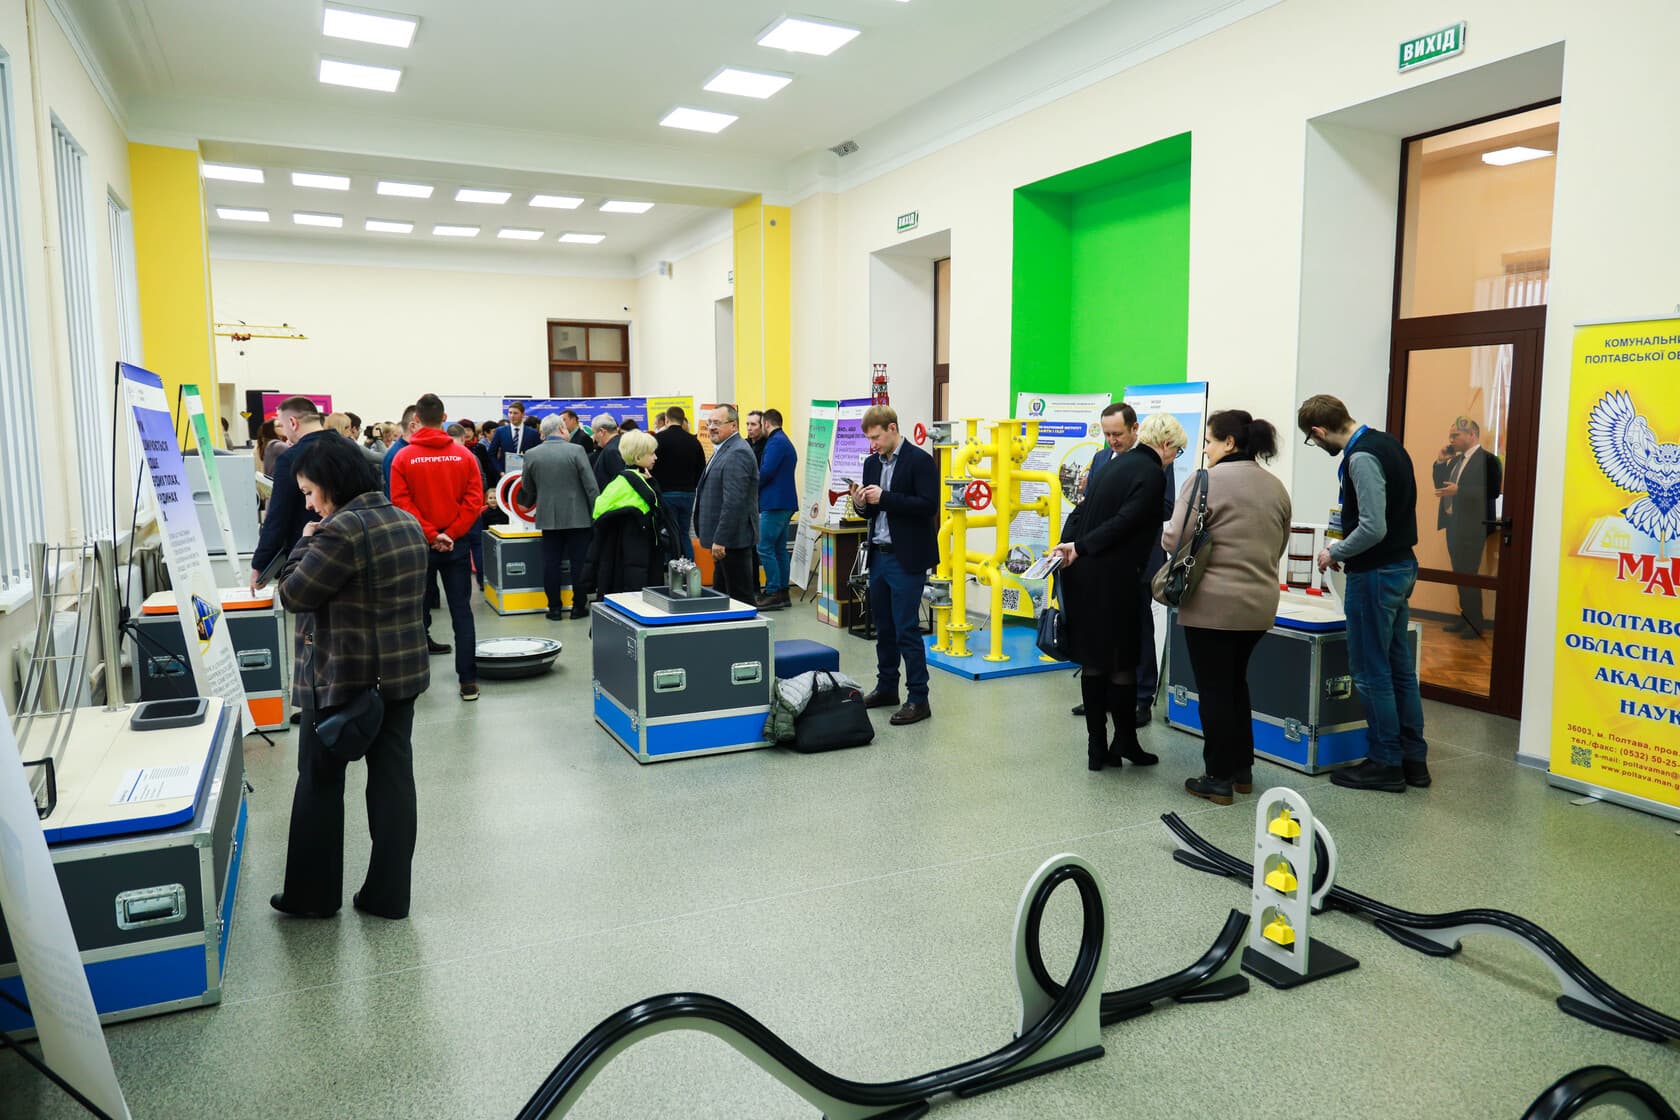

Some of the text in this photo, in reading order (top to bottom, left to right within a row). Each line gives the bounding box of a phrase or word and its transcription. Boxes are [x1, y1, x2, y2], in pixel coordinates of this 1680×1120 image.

[1403, 28, 1456, 62] ВИХІД
[1584, 350, 1664, 364] ПОЛТАВСЬКОЇ
[1565, 633, 1675, 666] ОБЛАСНА
[1620, 699, 1680, 726] НАУК
[1567, 723, 1594, 737] 36003,
[1608, 733, 1652, 751] Полтава,
[1620, 748, 1649, 761] (0532)
